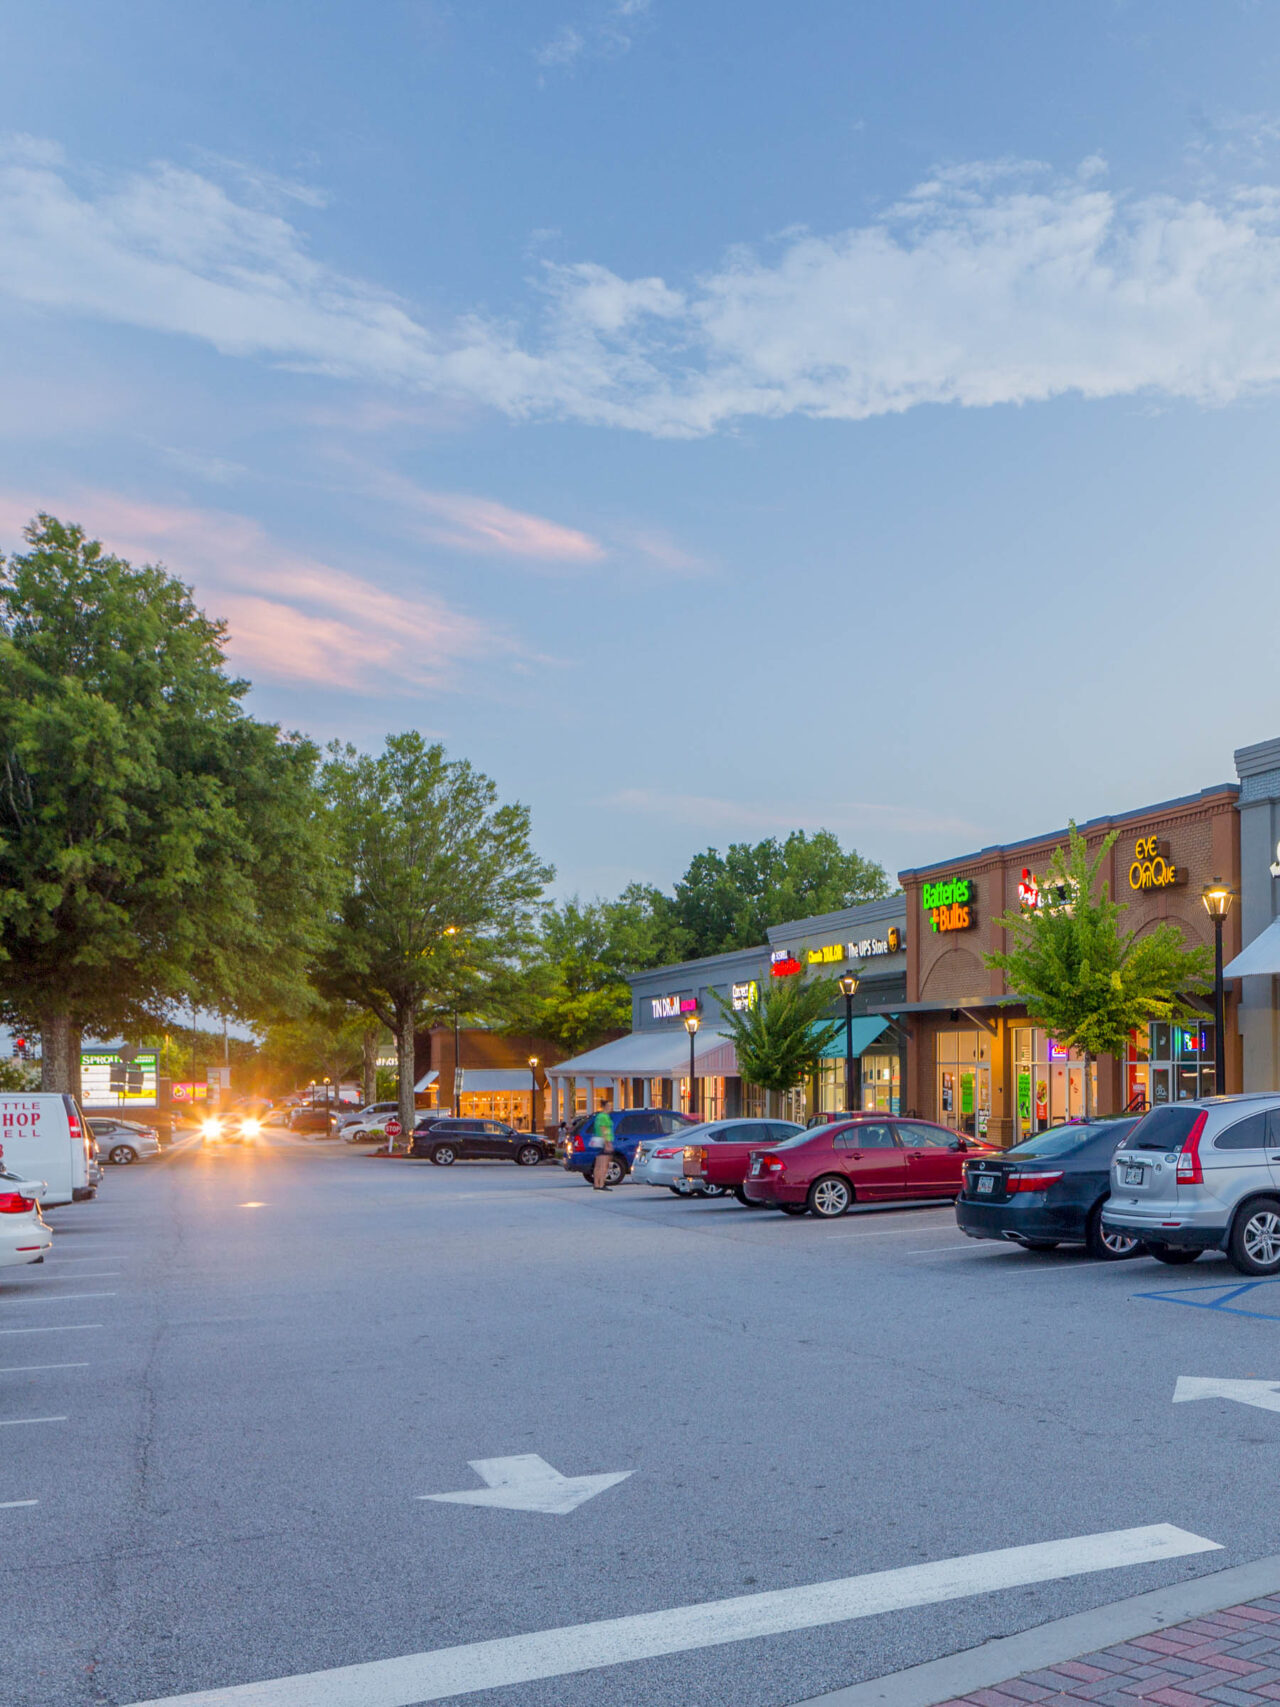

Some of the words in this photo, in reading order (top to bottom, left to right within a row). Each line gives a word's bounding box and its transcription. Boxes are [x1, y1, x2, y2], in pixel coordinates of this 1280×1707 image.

[1135, 835, 1157, 859] EYE
[923, 877, 969, 909] Batteries
[822, 944, 844, 963] TAILOR
[848, 942, 858, 958] The
[859, 940, 871, 957] UPS
[872, 939, 888, 954] Store
[652, 999, 662, 1018] TIN
[662, 996, 680, 1016] DRUM
